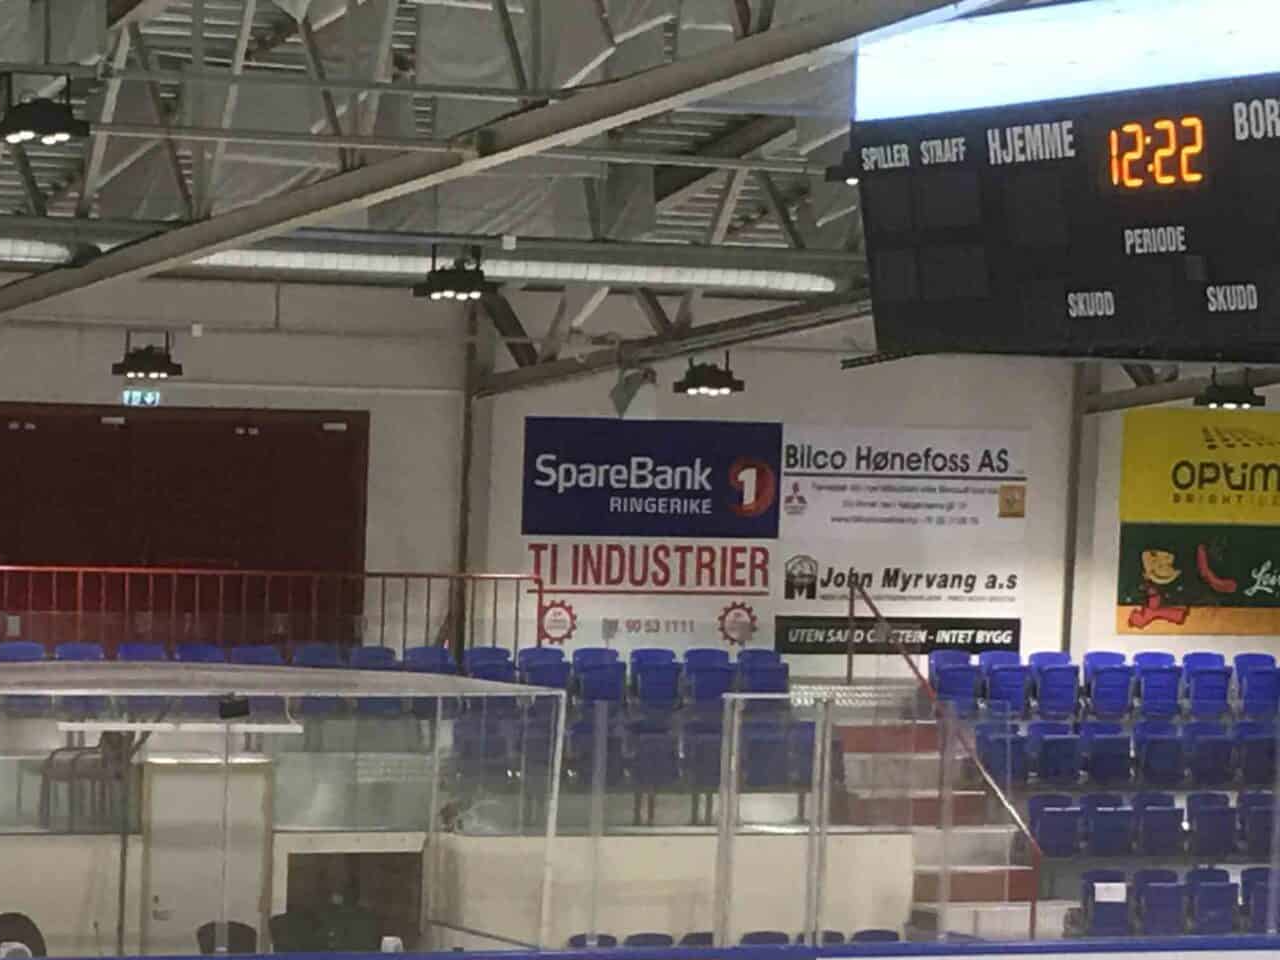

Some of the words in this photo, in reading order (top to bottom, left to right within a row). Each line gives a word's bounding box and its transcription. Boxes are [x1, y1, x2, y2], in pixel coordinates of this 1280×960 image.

[1233, 99, 1280, 140] BOR
[861, 143, 910, 171] SPILLER
[920, 137, 967, 165] STRAFF
[987, 120, 1076, 165] HJEMME
[1109, 116, 1203, 188] 12:22
[1125, 226, 1186, 255] PERIODE
[1068, 291, 1115, 318] SKUDD
[1207, 285, 1258, 312] SKUDD
[784, 444, 847, 471] Bilco
[855, 445, 970, 473] Hønefoss
[977, 448, 1009, 473] AS
[534, 453, 712, 494] SpareBank
[737, 467, 757, 505] 1
[609, 496, 712, 515] RINGERIKE
[528, 543, 557, 585] TI
[572, 544, 770, 588] INDUSTRIER
[820, 567, 873, 588] John
[881, 567, 977, 592] Myrvang
[984, 573, 1018, 589] a.s
[1243, 559, 1280, 597] Lei
[788, 628, 825, 642] UTEN
[935, 629, 974, 644] INTET
[975, 629, 1014, 645] BYGG
